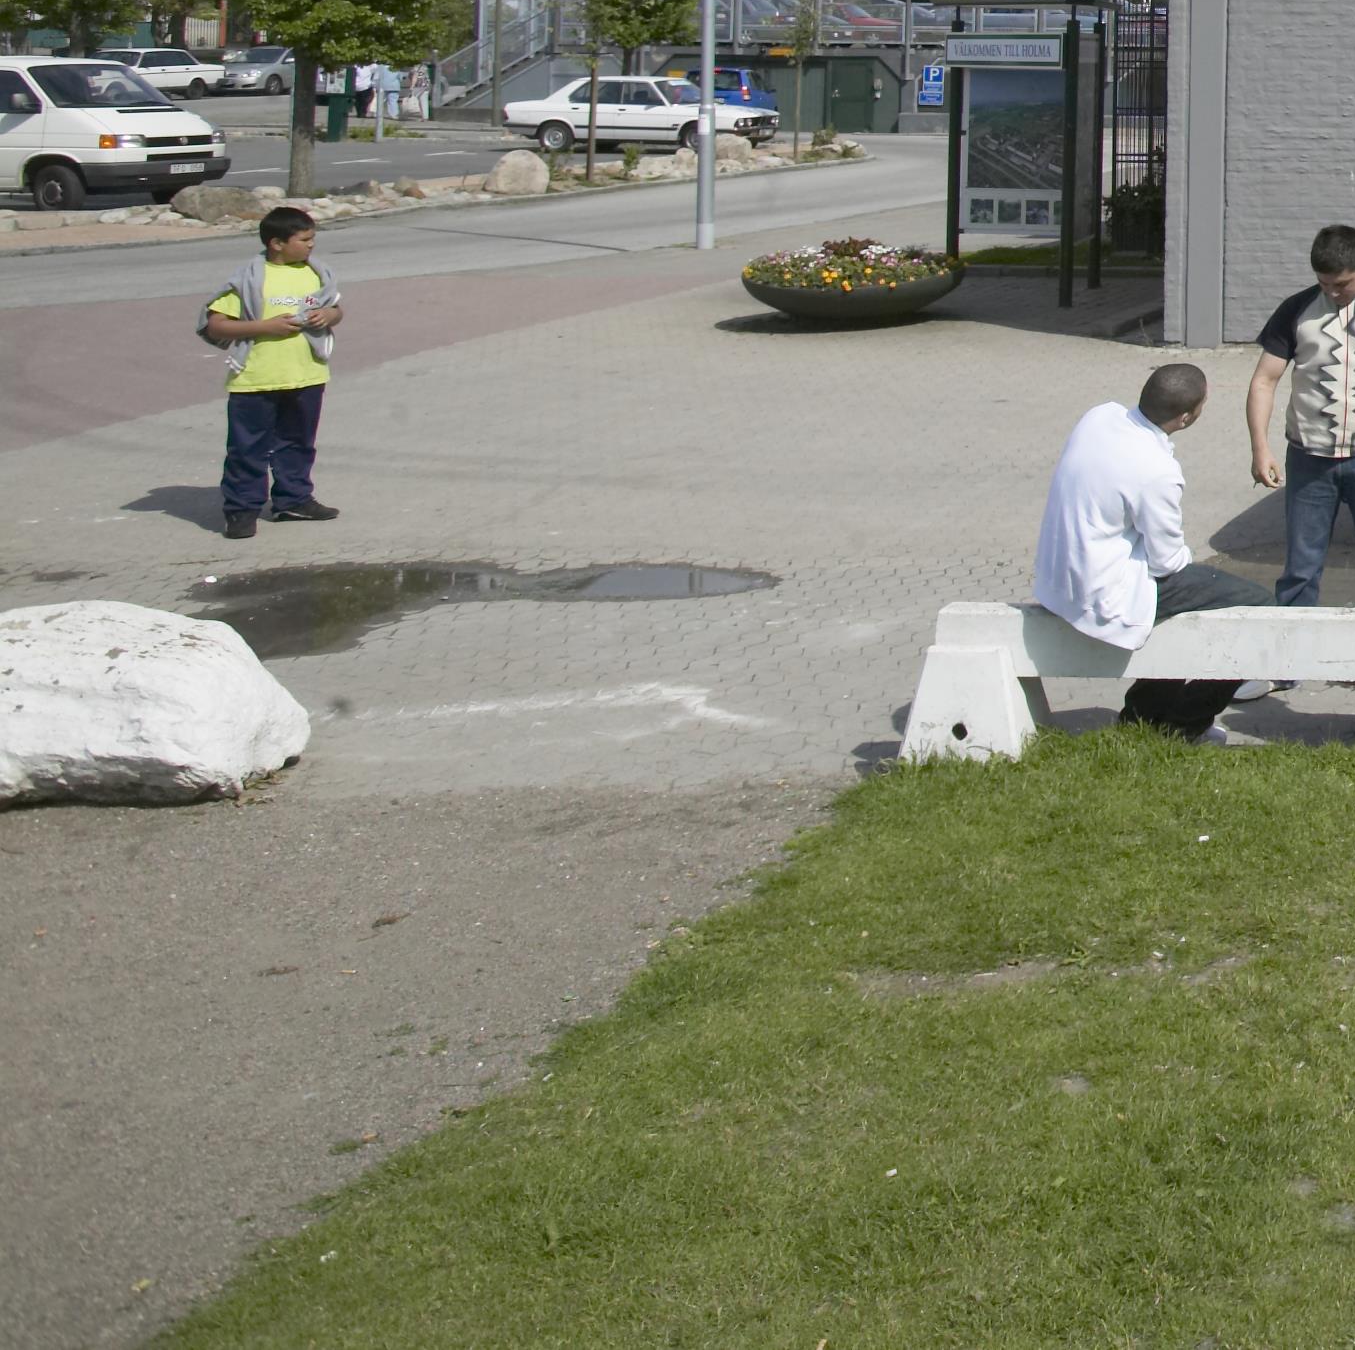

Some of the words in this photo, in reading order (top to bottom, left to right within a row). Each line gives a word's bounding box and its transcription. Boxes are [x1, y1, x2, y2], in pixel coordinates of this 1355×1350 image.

[953, 41, 1001, 58] VÄLKOMMEN
[1004, 44, 1020, 58] TILL
[1022, 44, 1052, 58] HOLMA
[929, 67, 940, 81] P
